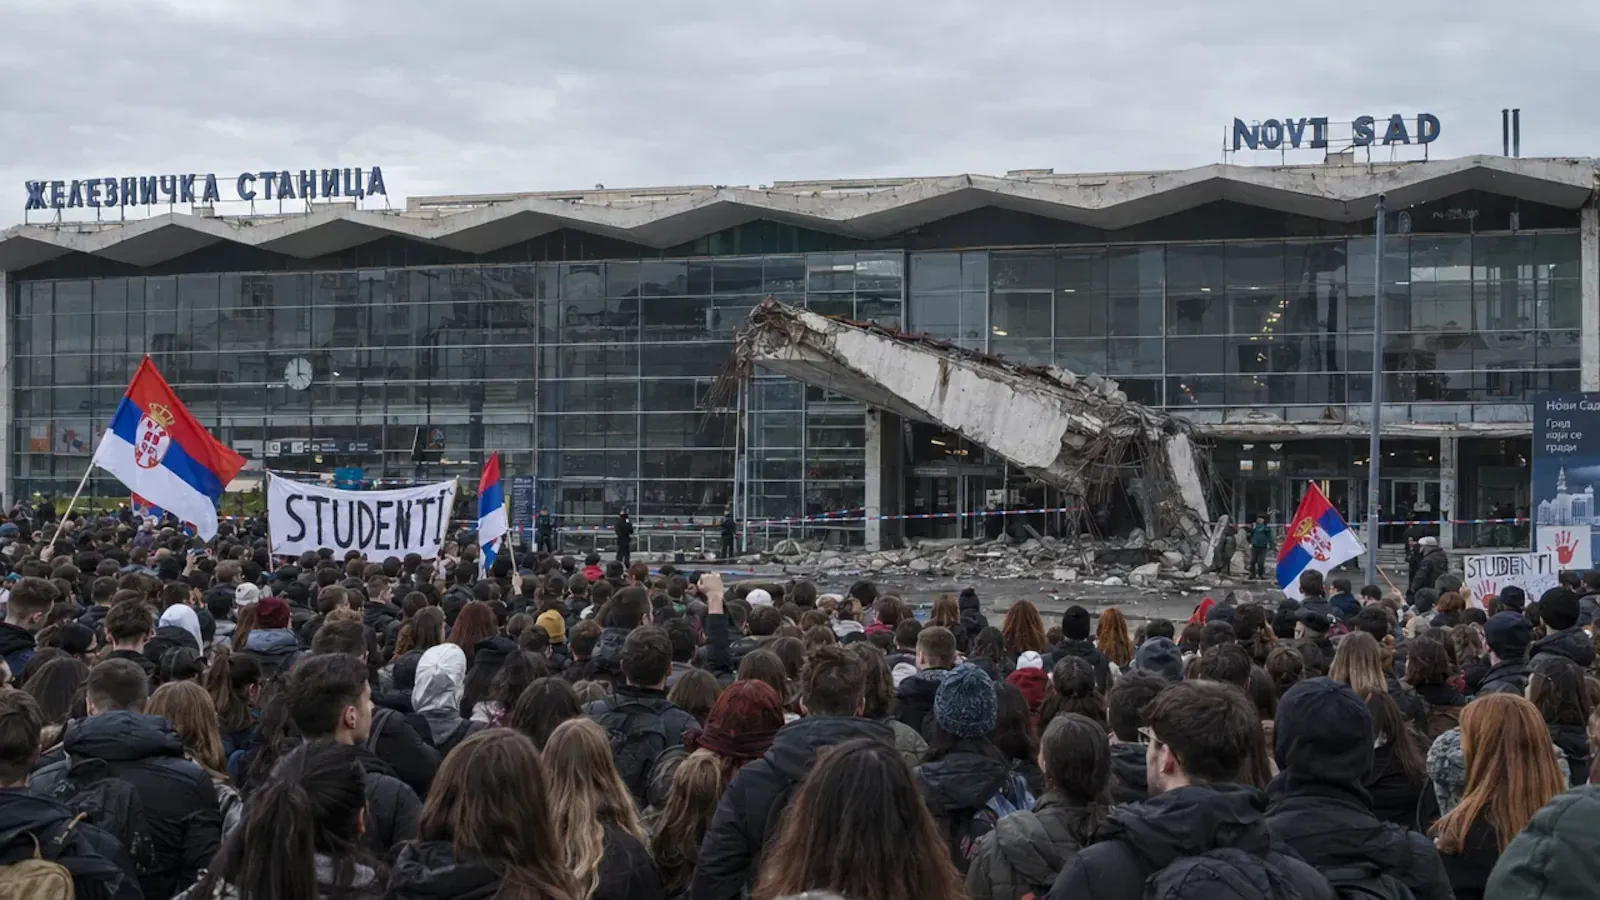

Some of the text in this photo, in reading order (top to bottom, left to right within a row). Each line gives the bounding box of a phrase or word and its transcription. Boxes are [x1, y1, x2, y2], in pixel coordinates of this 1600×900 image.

[1234, 113, 1441, 150] NOVI SAD
[25, 166, 387, 210] ЖЕЛЕЗНИЧКА СТАНИЦА
[1467, 553, 1554, 579] STUDENTI
